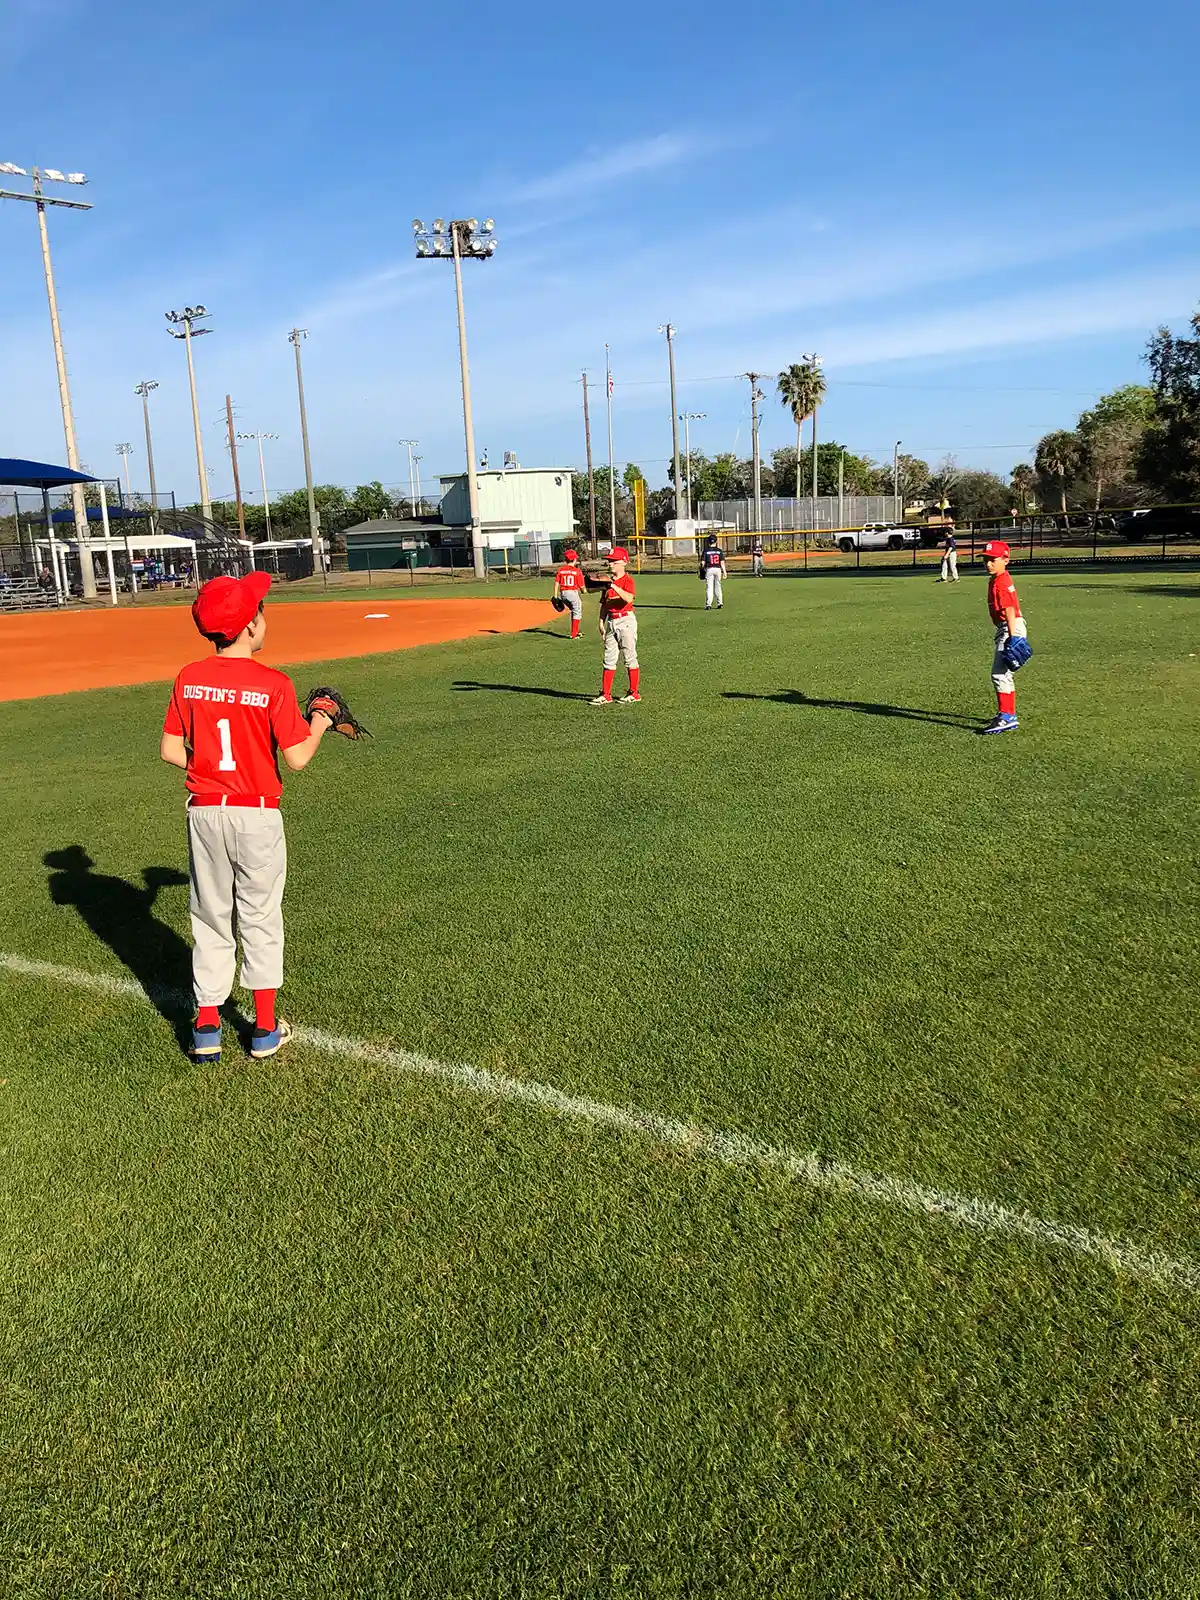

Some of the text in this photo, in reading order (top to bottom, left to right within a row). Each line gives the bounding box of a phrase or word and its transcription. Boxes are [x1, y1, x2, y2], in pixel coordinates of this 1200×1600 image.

[710, 554, 720, 564] 12
[562, 575, 574, 586] 10
[183, 684, 236, 703] DUSTIN'S
[216, 718, 236, 771] 1
